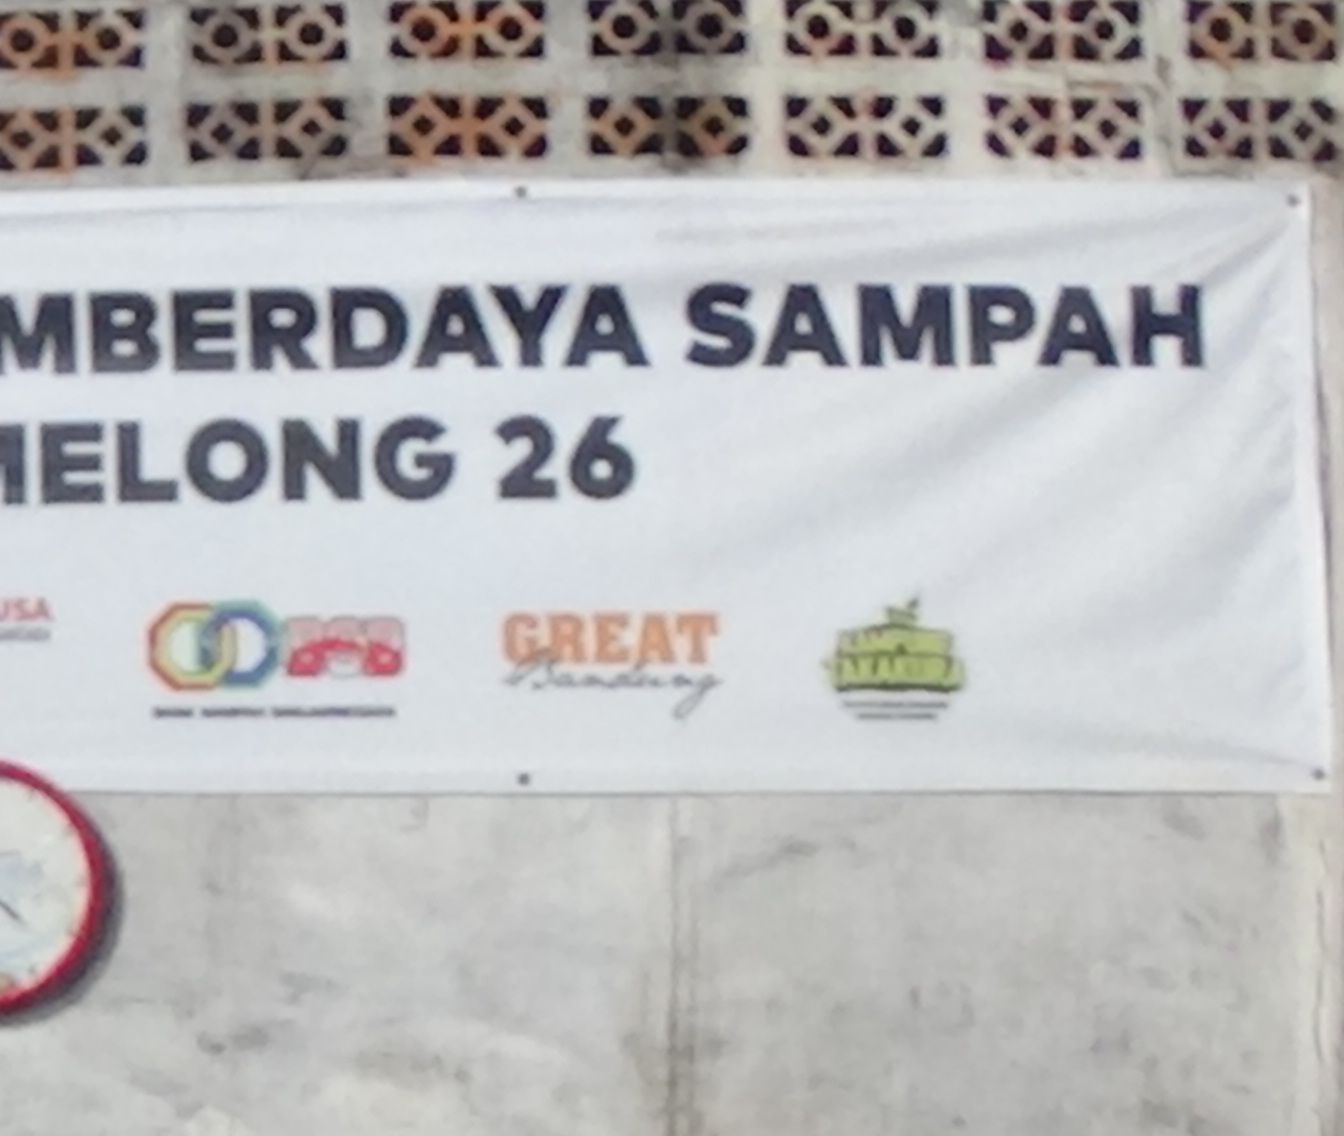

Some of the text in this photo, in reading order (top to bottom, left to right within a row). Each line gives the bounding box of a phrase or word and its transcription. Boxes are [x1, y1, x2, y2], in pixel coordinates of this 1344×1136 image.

[684, 282, 1206, 370] SAMPAH
[494, 416, 637, 501] 26
[502, 612, 721, 665] GREAT
